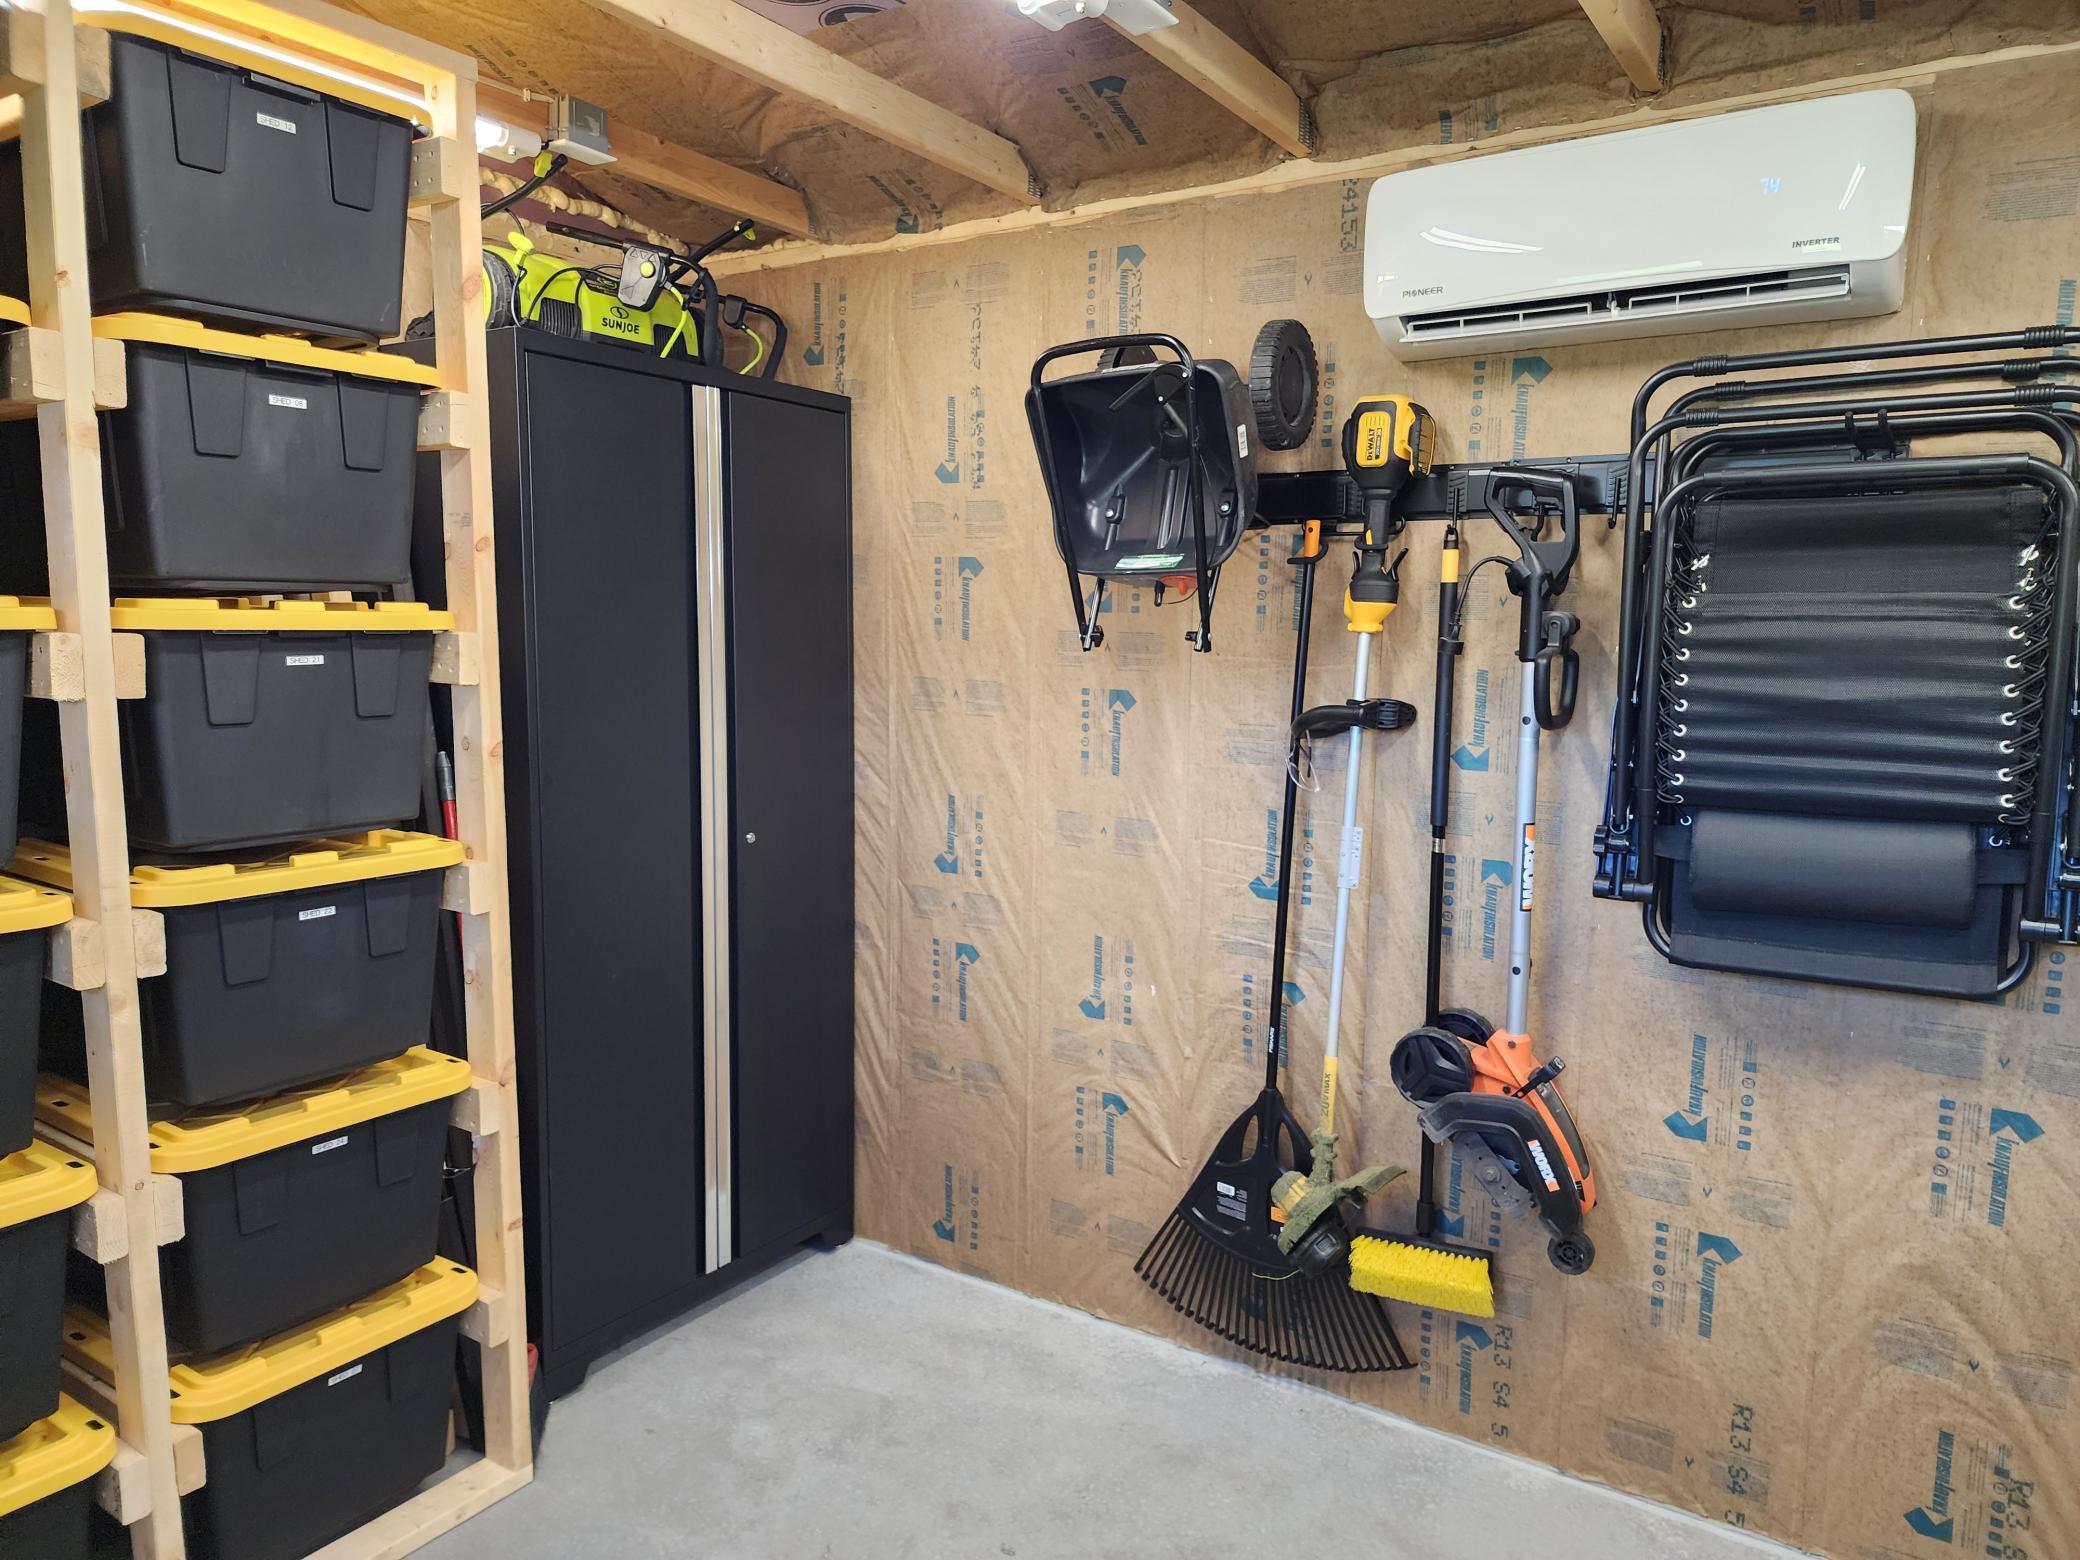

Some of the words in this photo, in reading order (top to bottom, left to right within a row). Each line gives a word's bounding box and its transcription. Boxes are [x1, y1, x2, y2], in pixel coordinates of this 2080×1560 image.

[260, 116, 281, 128] SHED
[1791, 237, 1840, 249] INVERTER
[1402, 286, 1444, 299] PIONEER
[289, 656, 309, 665] SHED
[302, 908, 321, 918] SHED
[1323, 1071, 1331, 1094] MAX
[1529, 1142, 1556, 1181] WORX
[1493, 1323, 1513, 1370] R13
[1491, 1422, 1510, 1440] 5
[1729, 1403, 1753, 1453] R13
[2006, 1478, 2034, 1531] R13
[1724, 1509, 1746, 1529] 5
